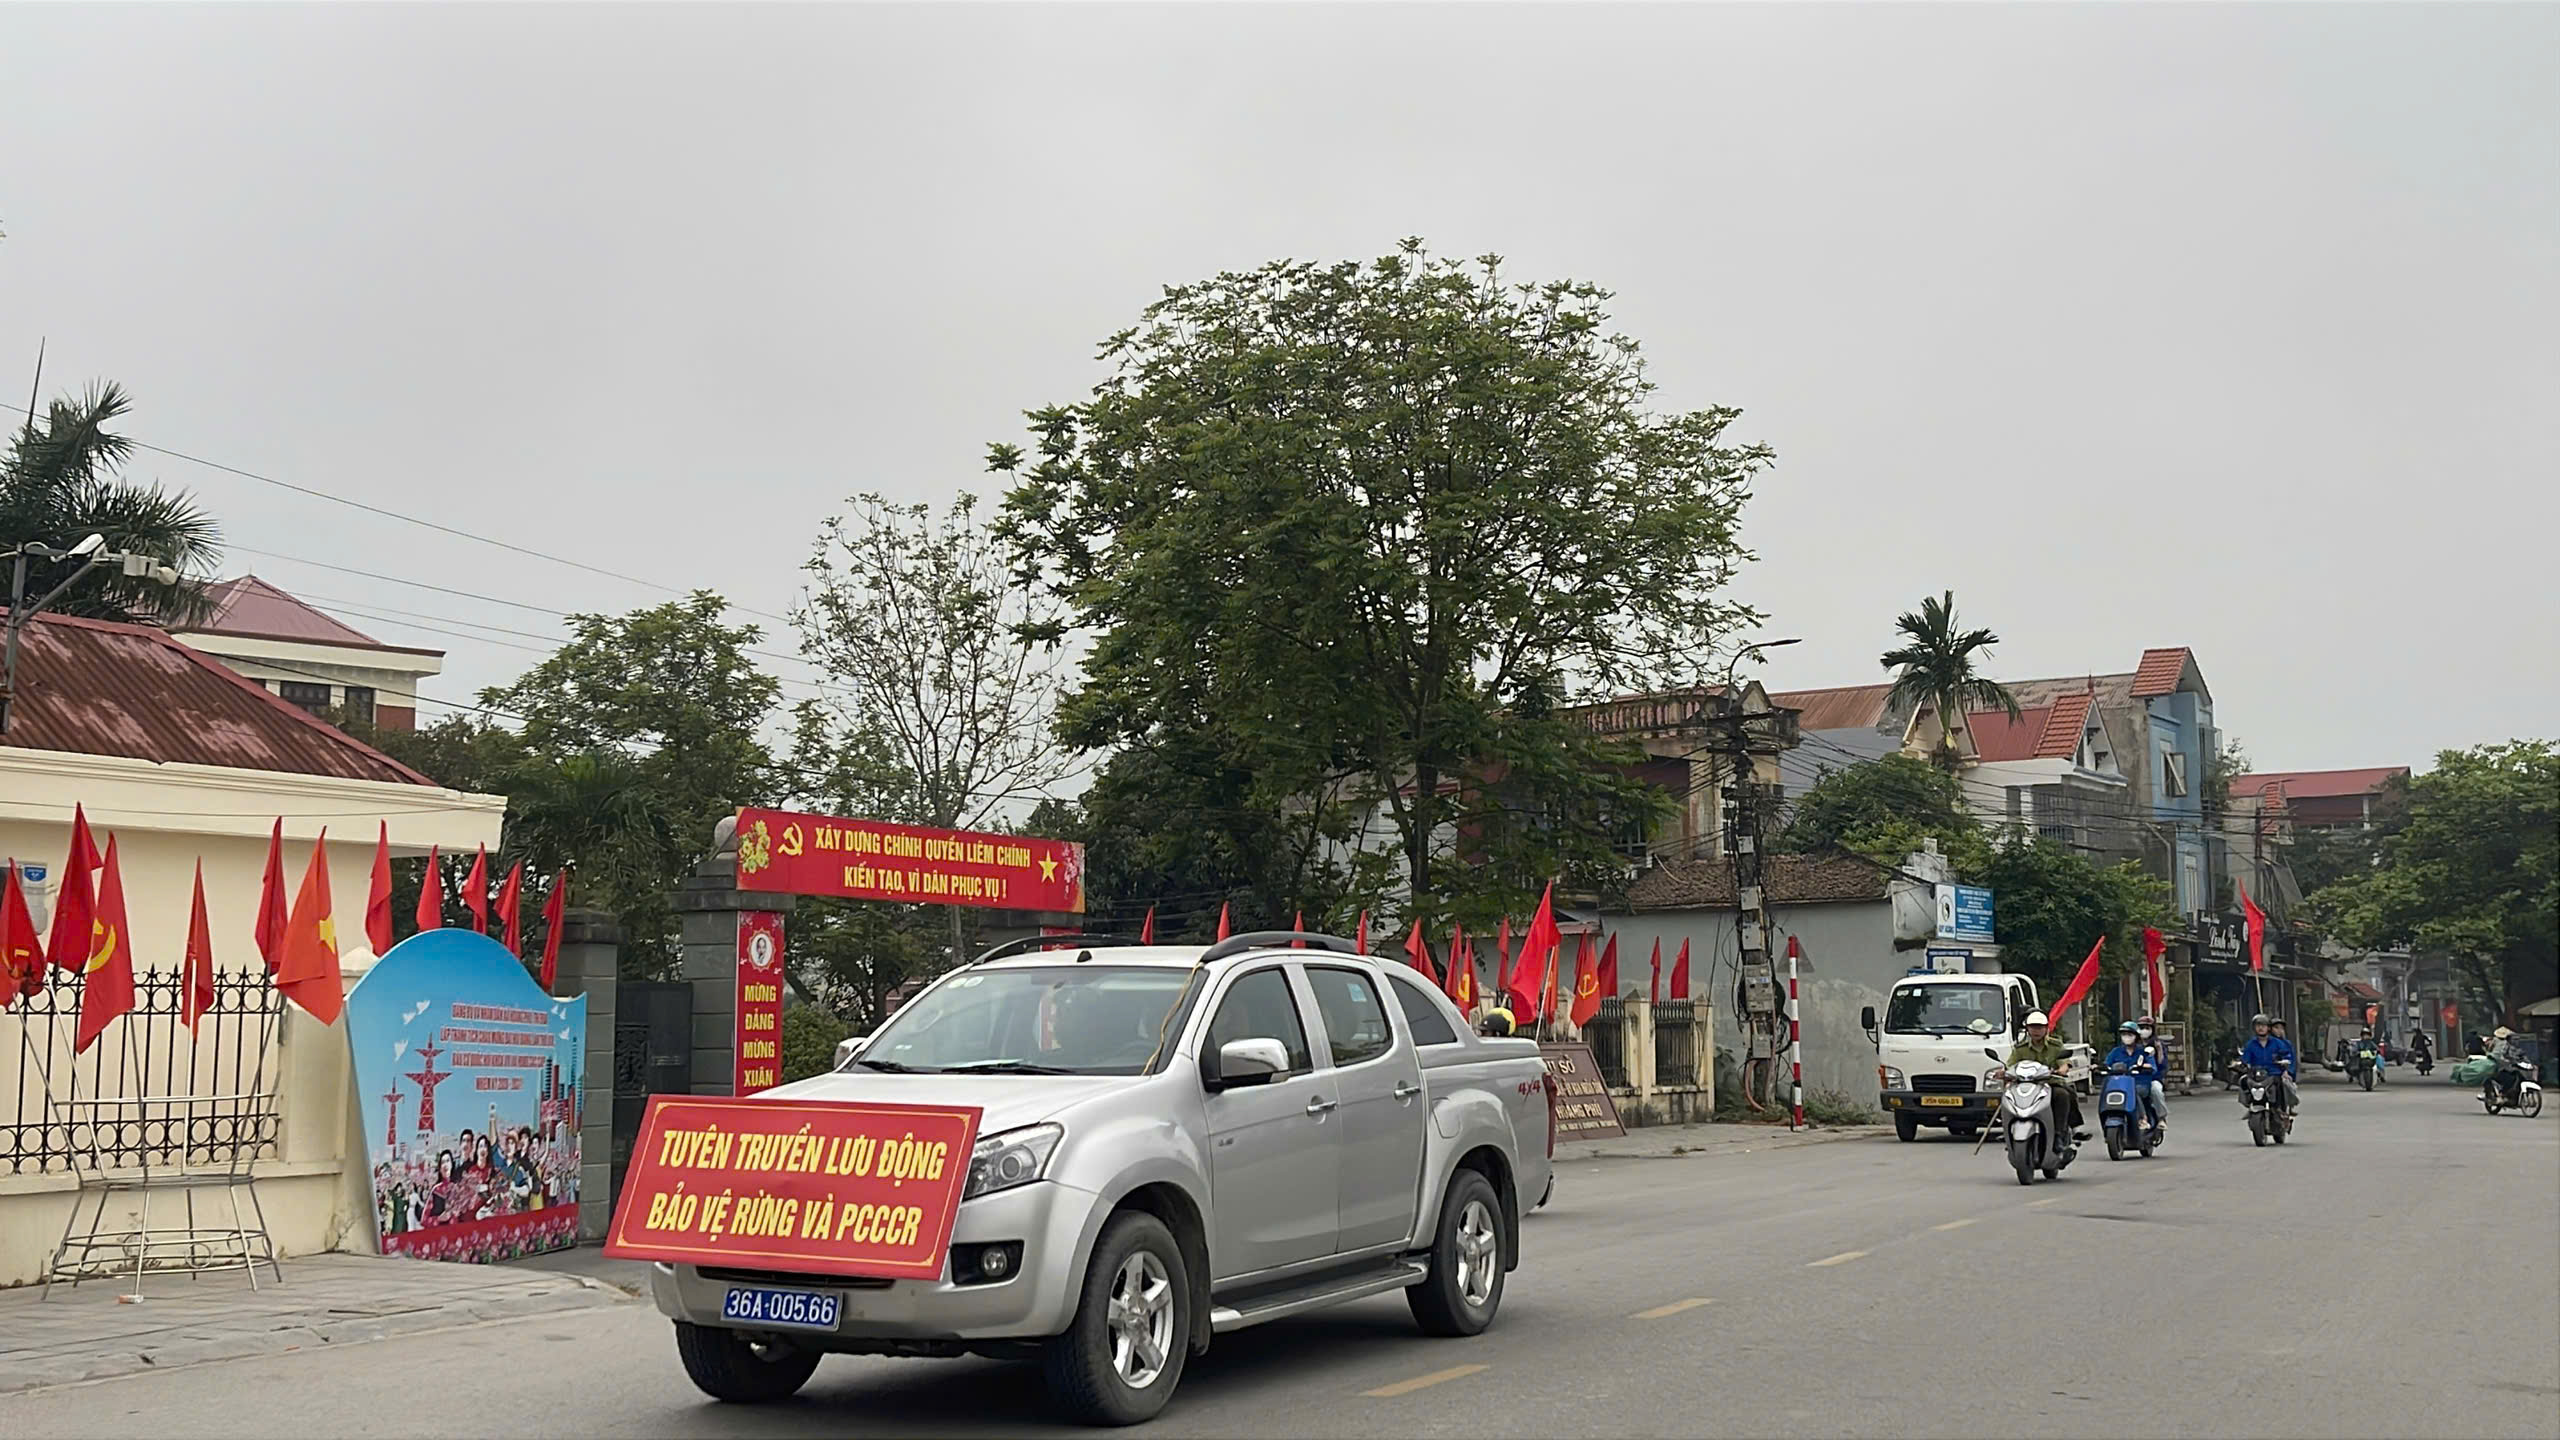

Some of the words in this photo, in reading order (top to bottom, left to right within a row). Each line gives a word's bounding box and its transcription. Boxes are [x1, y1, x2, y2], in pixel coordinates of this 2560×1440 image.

[816, 824, 841, 850] XÂY
[845, 830, 880, 857] DỰNG
[884, 832, 922, 858] CHÍNH
[967, 840, 994, 864] LIÊM
[997, 843, 1030, 868] CHÍNH
[844, 861, 875, 889] KIẾN
[878, 868, 905, 895] TẠO,
[908, 868, 920, 893] VÌ
[923, 870, 948, 894] DÂN
[951, 875, 982, 901] PHỤC
[985, 877, 999, 903] VỤ
[744, 982, 777, 1003] MỪNG
[745, 1008, 775, 1031] ĐẢNG
[743, 1038, 775, 1059] MỪNG
[743, 1066, 774, 1088] XUÂN
[659, 1124, 735, 1170] TUYÊN
[734, 1122, 826, 1173] TRUYỀN
[824, 1134, 877, 1177] LƯU
[876, 1132, 948, 1187] ĐỘNG
[645, 1181, 698, 1232] BẢO
[698, 1188, 732, 1242] VỆ
[730, 1189, 798, 1237] RỪNG
[801, 1193, 834, 1240] VÀ
[835, 1202, 923, 1246] PCCCR
[727, 1289, 834, 1324] 36A-005.66
